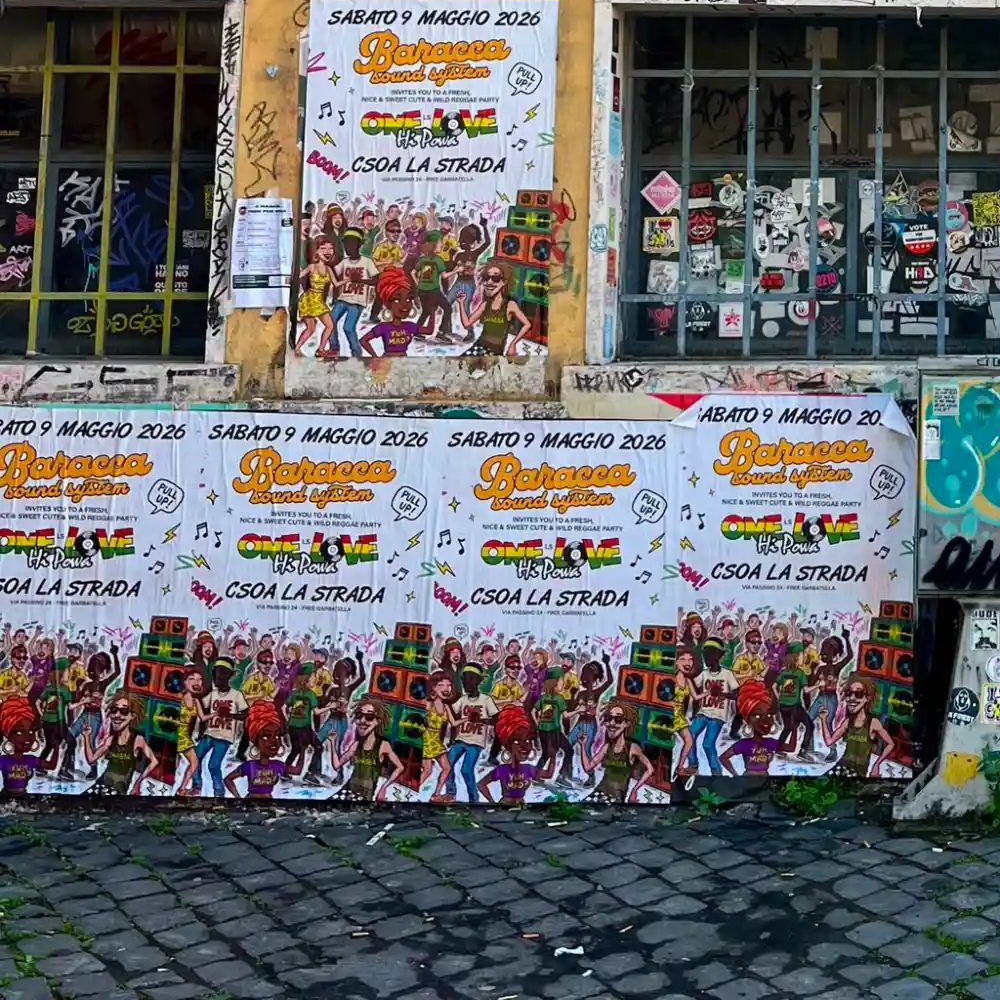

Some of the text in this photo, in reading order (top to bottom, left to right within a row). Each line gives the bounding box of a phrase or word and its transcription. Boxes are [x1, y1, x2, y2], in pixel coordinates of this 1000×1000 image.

[327, 10, 541, 26] SABATO 9 MAGGIO 2026
[353, 29, 512, 74] Baracca
[370, 63, 491, 86] sound system
[516, 65, 536, 82] PULL
[515, 77, 532, 90] UP!
[360, 108, 498, 138] ONE LOVE
[306, 150, 350, 183] BOOM!
[352, 157, 506, 173] CSOA LA STRADA
[342, 281, 365, 295] LOVE
[699, 407, 758, 423] ABATO
[762, 409, 773, 424] 9
[778, 408, 852, 425] MAGGIO
[40, 421, 186, 440] 9 MAGGIO 2026
[208, 424, 429, 447] SABATO 9 MAGGIO 2026
[448, 432, 666, 449] SABATO 9 MAGGIO 2026
[713, 428, 874, 475] Baracca
[232, 446, 397, 493] Baracca
[473, 452, 636, 500] Baracca
[730, 464, 853, 489] sound system
[878, 469, 899, 486] PULL
[877, 482, 894, 495] UP!
[491, 489, 615, 514] sound system
[641, 493, 660, 509] PULL
[639, 506, 657, 518] UP!
[721, 512, 861, 545] ONE LOVE
[481, 537, 622, 570] ONE LOVE
[711, 562, 869, 582] CSOA LA STRADA
[36, 579, 141, 598] LA STRADA
[225, 581, 386, 603] CSOA LA STRADA
[471, 587, 630, 606] CSOA LA STRADA
[702, 698, 725, 710] LOVE
[460, 723, 485, 735] LOVE
